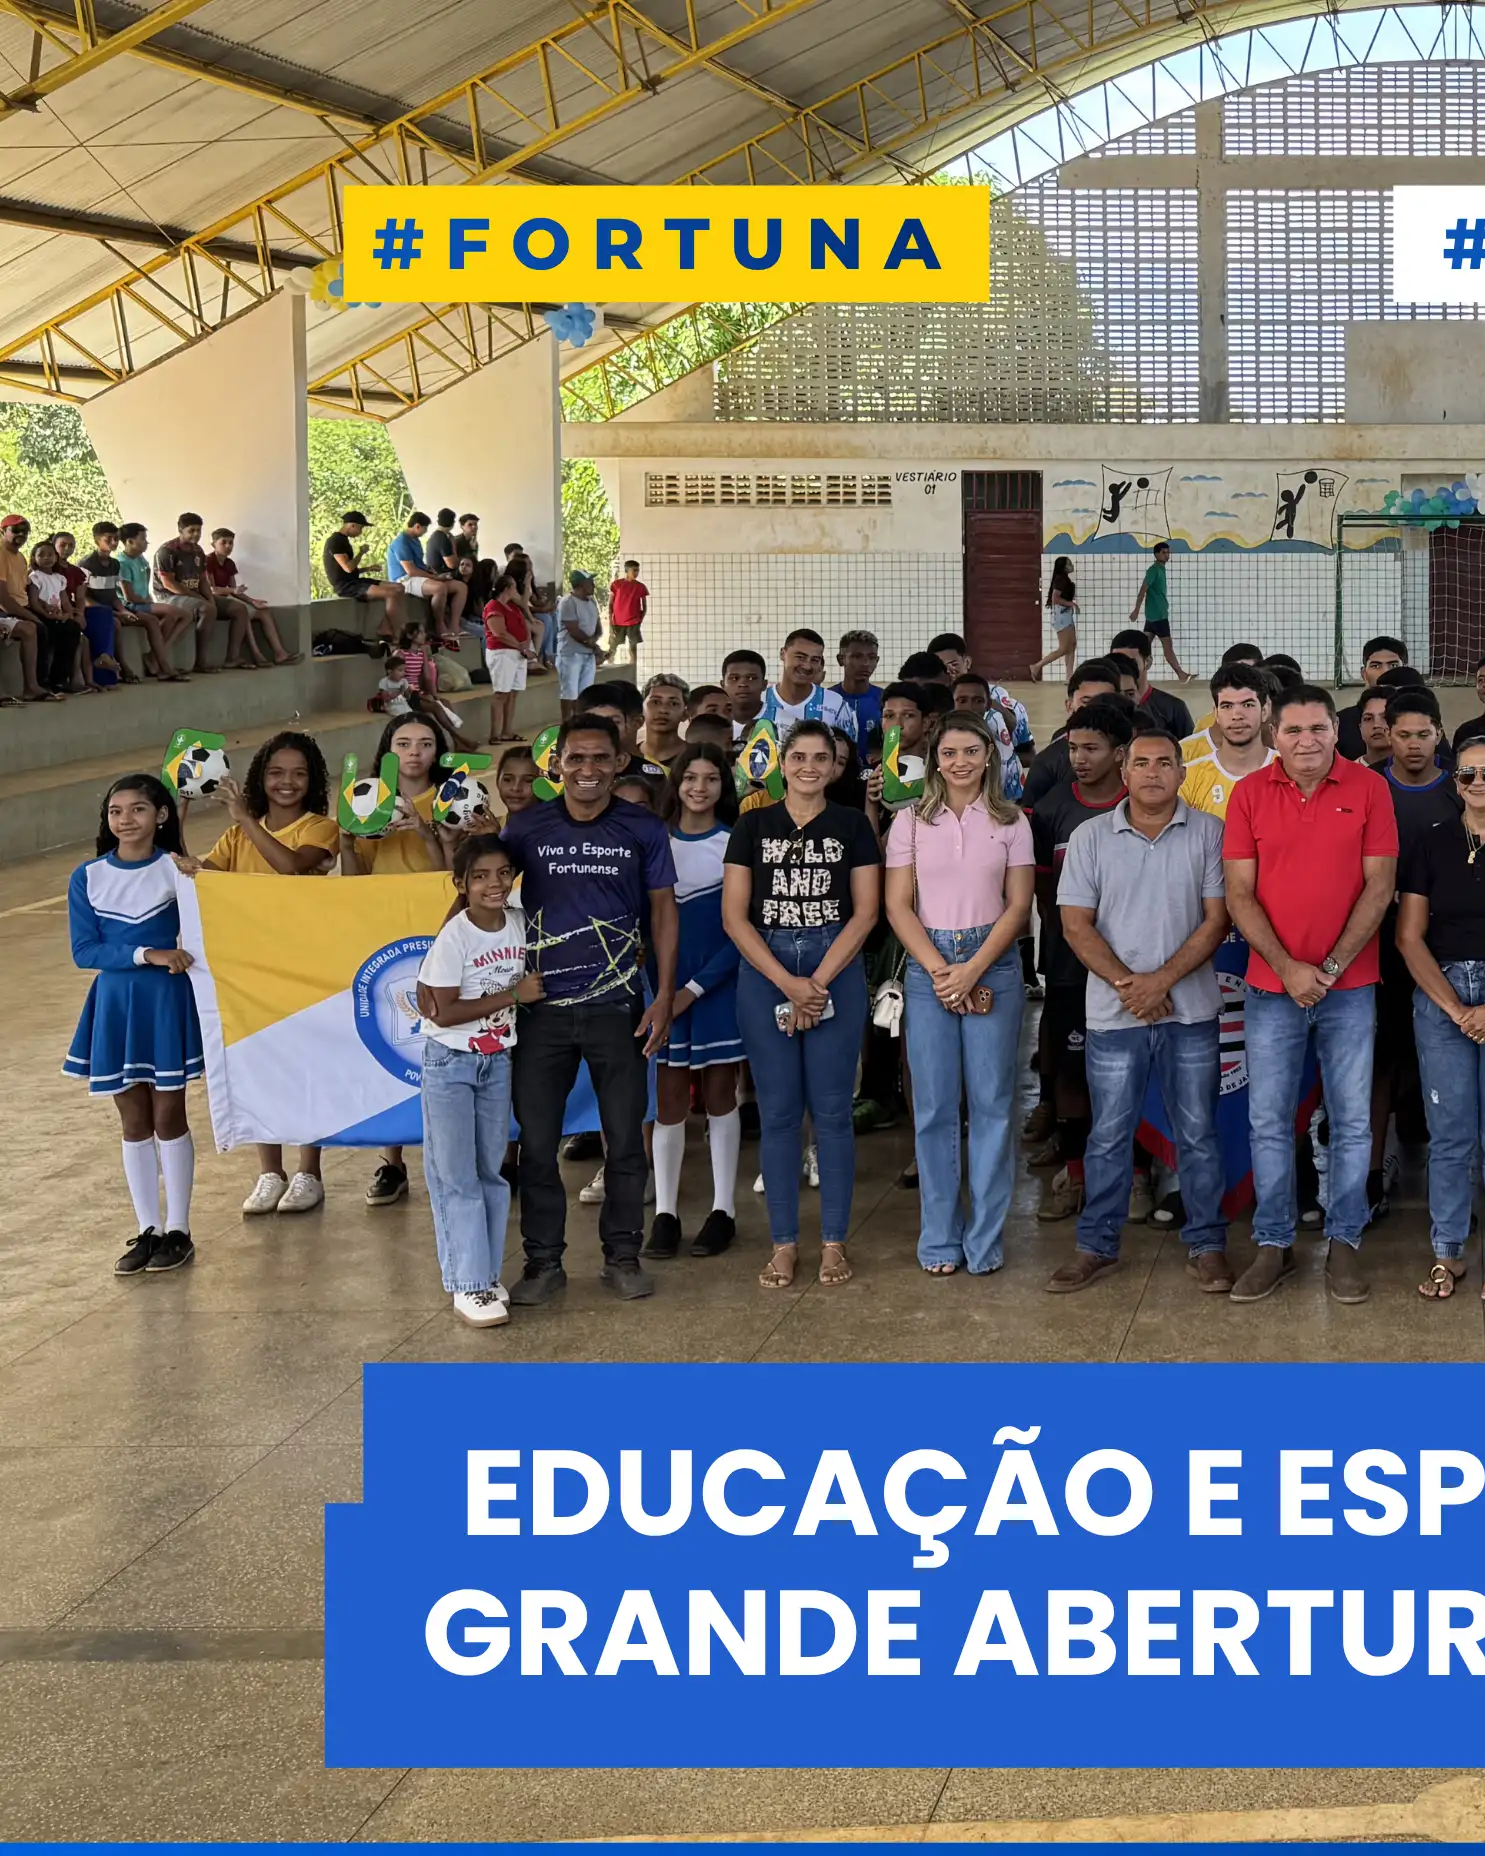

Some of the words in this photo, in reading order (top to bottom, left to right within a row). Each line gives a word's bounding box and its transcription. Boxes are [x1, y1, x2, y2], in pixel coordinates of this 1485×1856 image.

[895, 469, 957, 482] VESTIÁRIO
[924, 484, 936, 495] 01
[537, 844, 564, 858] Viva
[569, 845, 577, 856] o
[582, 842, 632, 859] Esporte
[761, 837, 845, 865] WLD
[548, 862, 620, 876] Fortunense
[771, 868, 832, 897] AND
[762, 899, 841, 927] FREE
[402, 940, 435, 953] PRESI
[360, 947, 402, 983] INTEGRADA
[473, 946, 527, 969] MINNIE
[488, 964, 515, 976] Mouse
[359, 984, 371, 1018] UNIDADE
